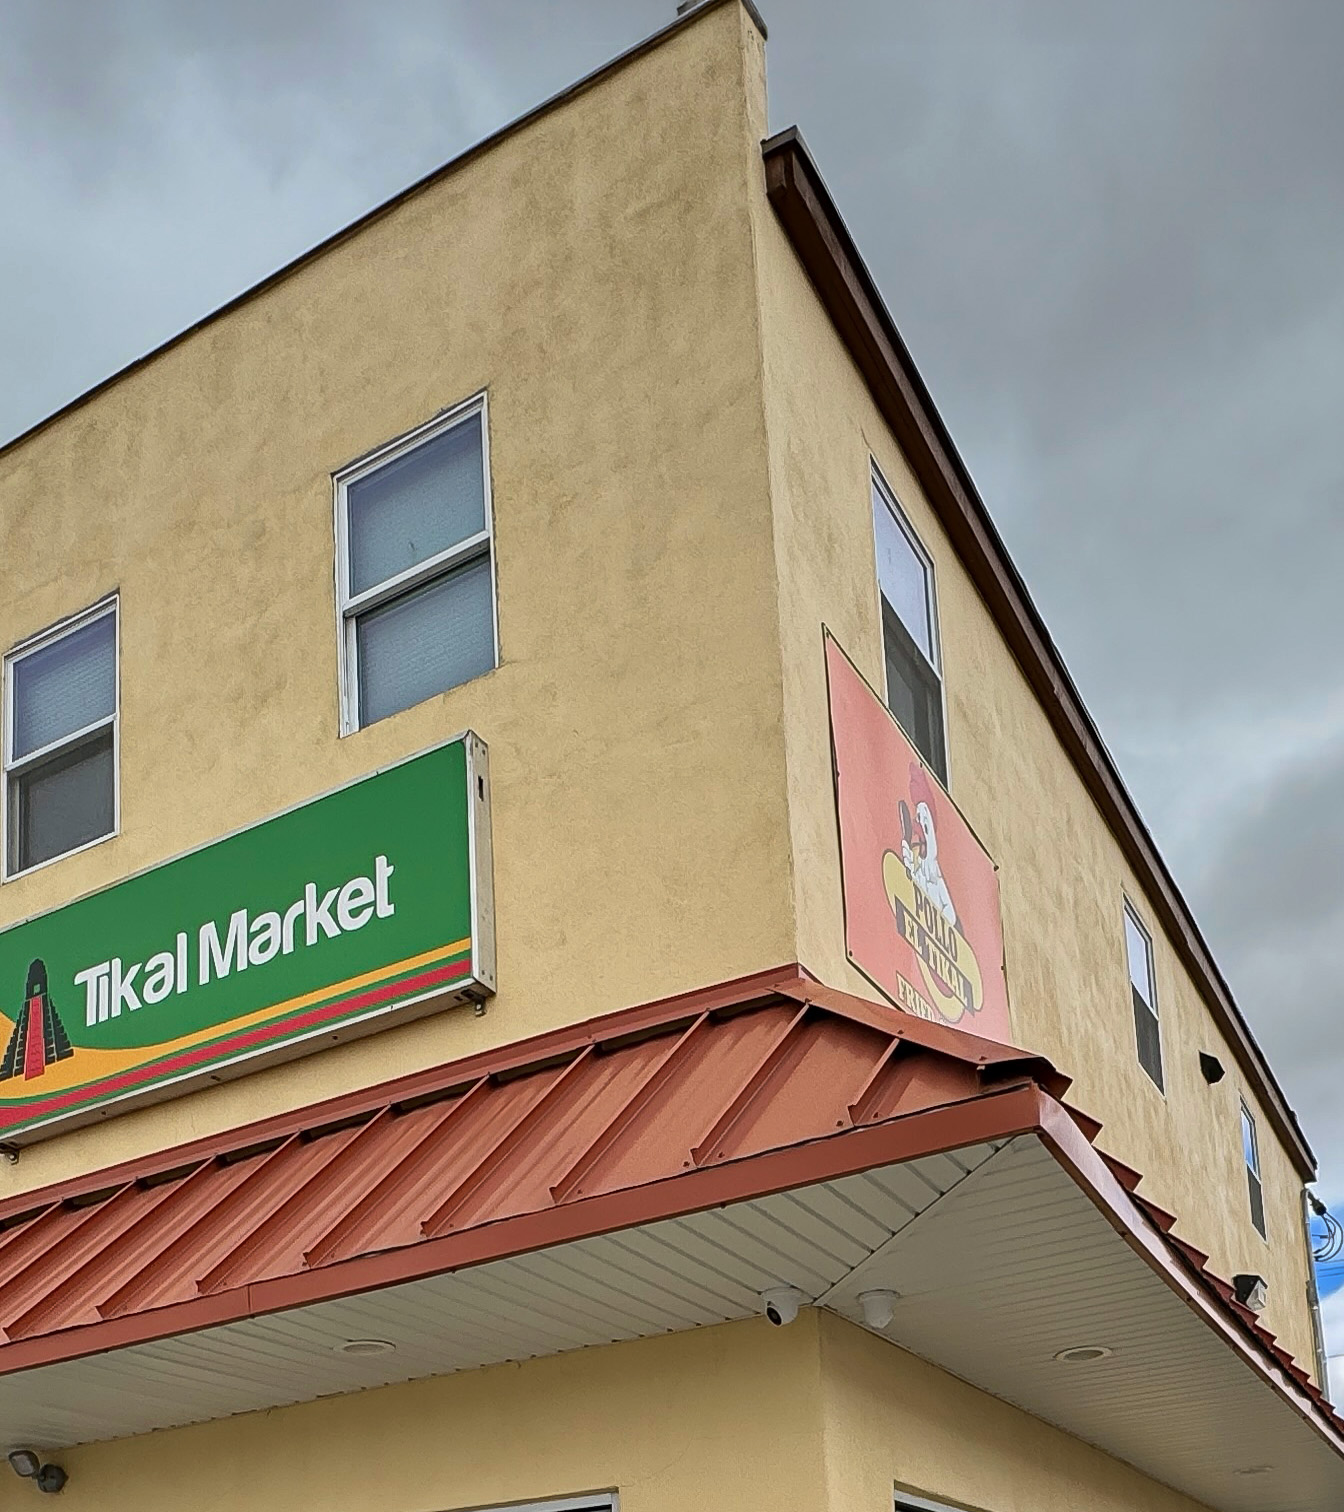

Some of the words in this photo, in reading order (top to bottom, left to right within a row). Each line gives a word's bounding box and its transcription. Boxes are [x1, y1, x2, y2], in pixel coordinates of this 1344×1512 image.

[73, 930, 189, 1028] Tikal
[198, 854, 396, 986] Market
[903, 910, 923, 956] EL
[924, 934, 969, 1008] TIKAL
[912, 881, 958, 963] POLLO
